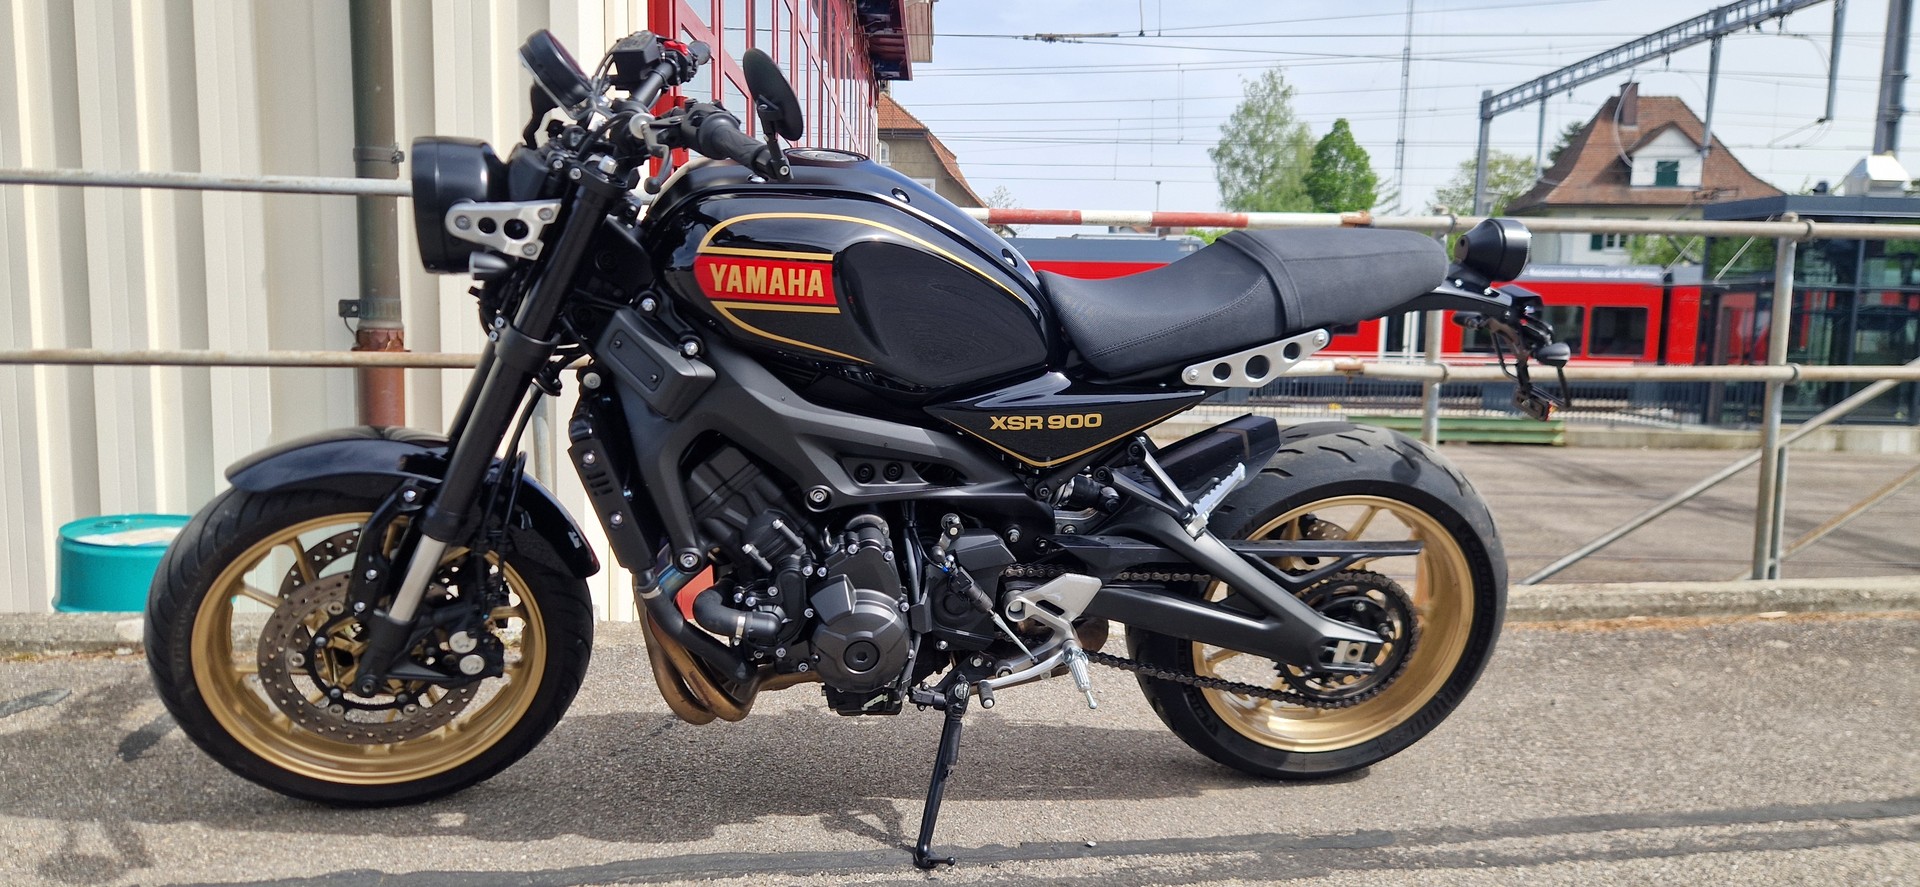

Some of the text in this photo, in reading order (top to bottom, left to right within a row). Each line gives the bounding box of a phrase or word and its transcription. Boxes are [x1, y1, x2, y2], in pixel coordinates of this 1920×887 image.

[709, 263, 825, 297] YAMAHA
[989, 413, 1103, 430] XSR 900
